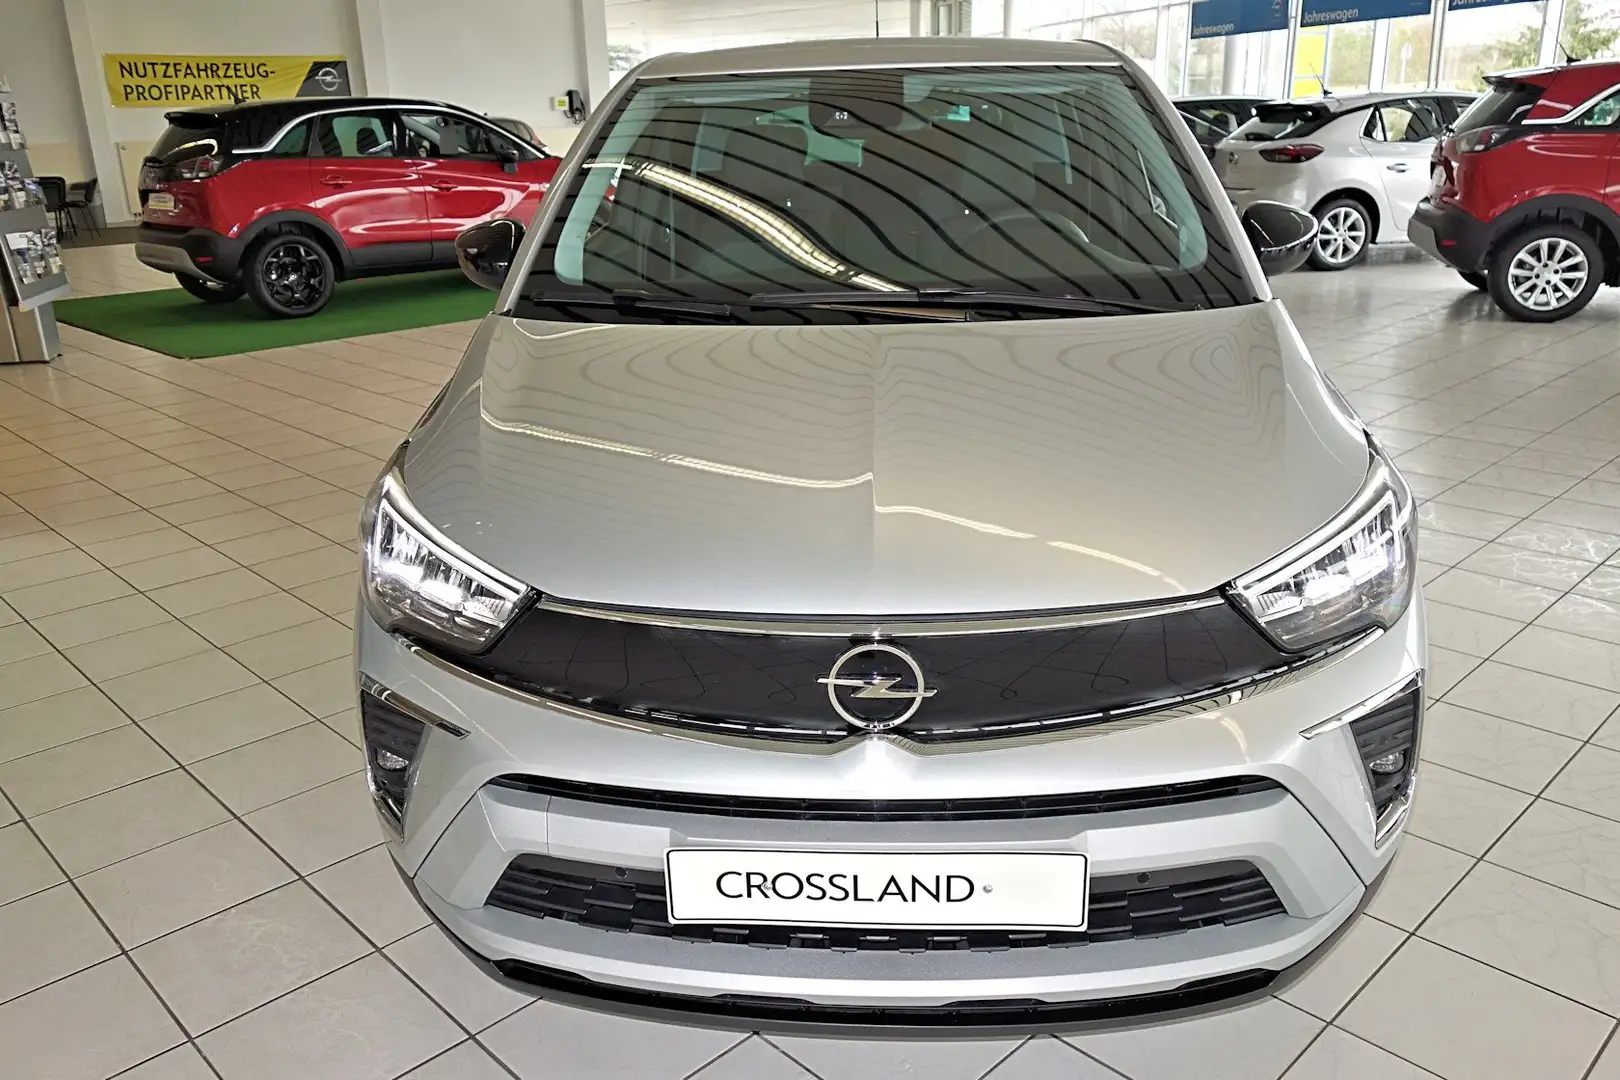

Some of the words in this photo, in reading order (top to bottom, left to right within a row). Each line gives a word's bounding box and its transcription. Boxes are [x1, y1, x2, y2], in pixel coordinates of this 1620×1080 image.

[1303, 8, 1359, 23] Jahreswagen
[1192, 23, 1235, 36] Jahreswagen
[118, 61, 276, 79] NUTZFAHRZEUG-
[122, 83, 262, 101] PROFIPARTNER
[715, 870, 975, 903] CROSSLAND
